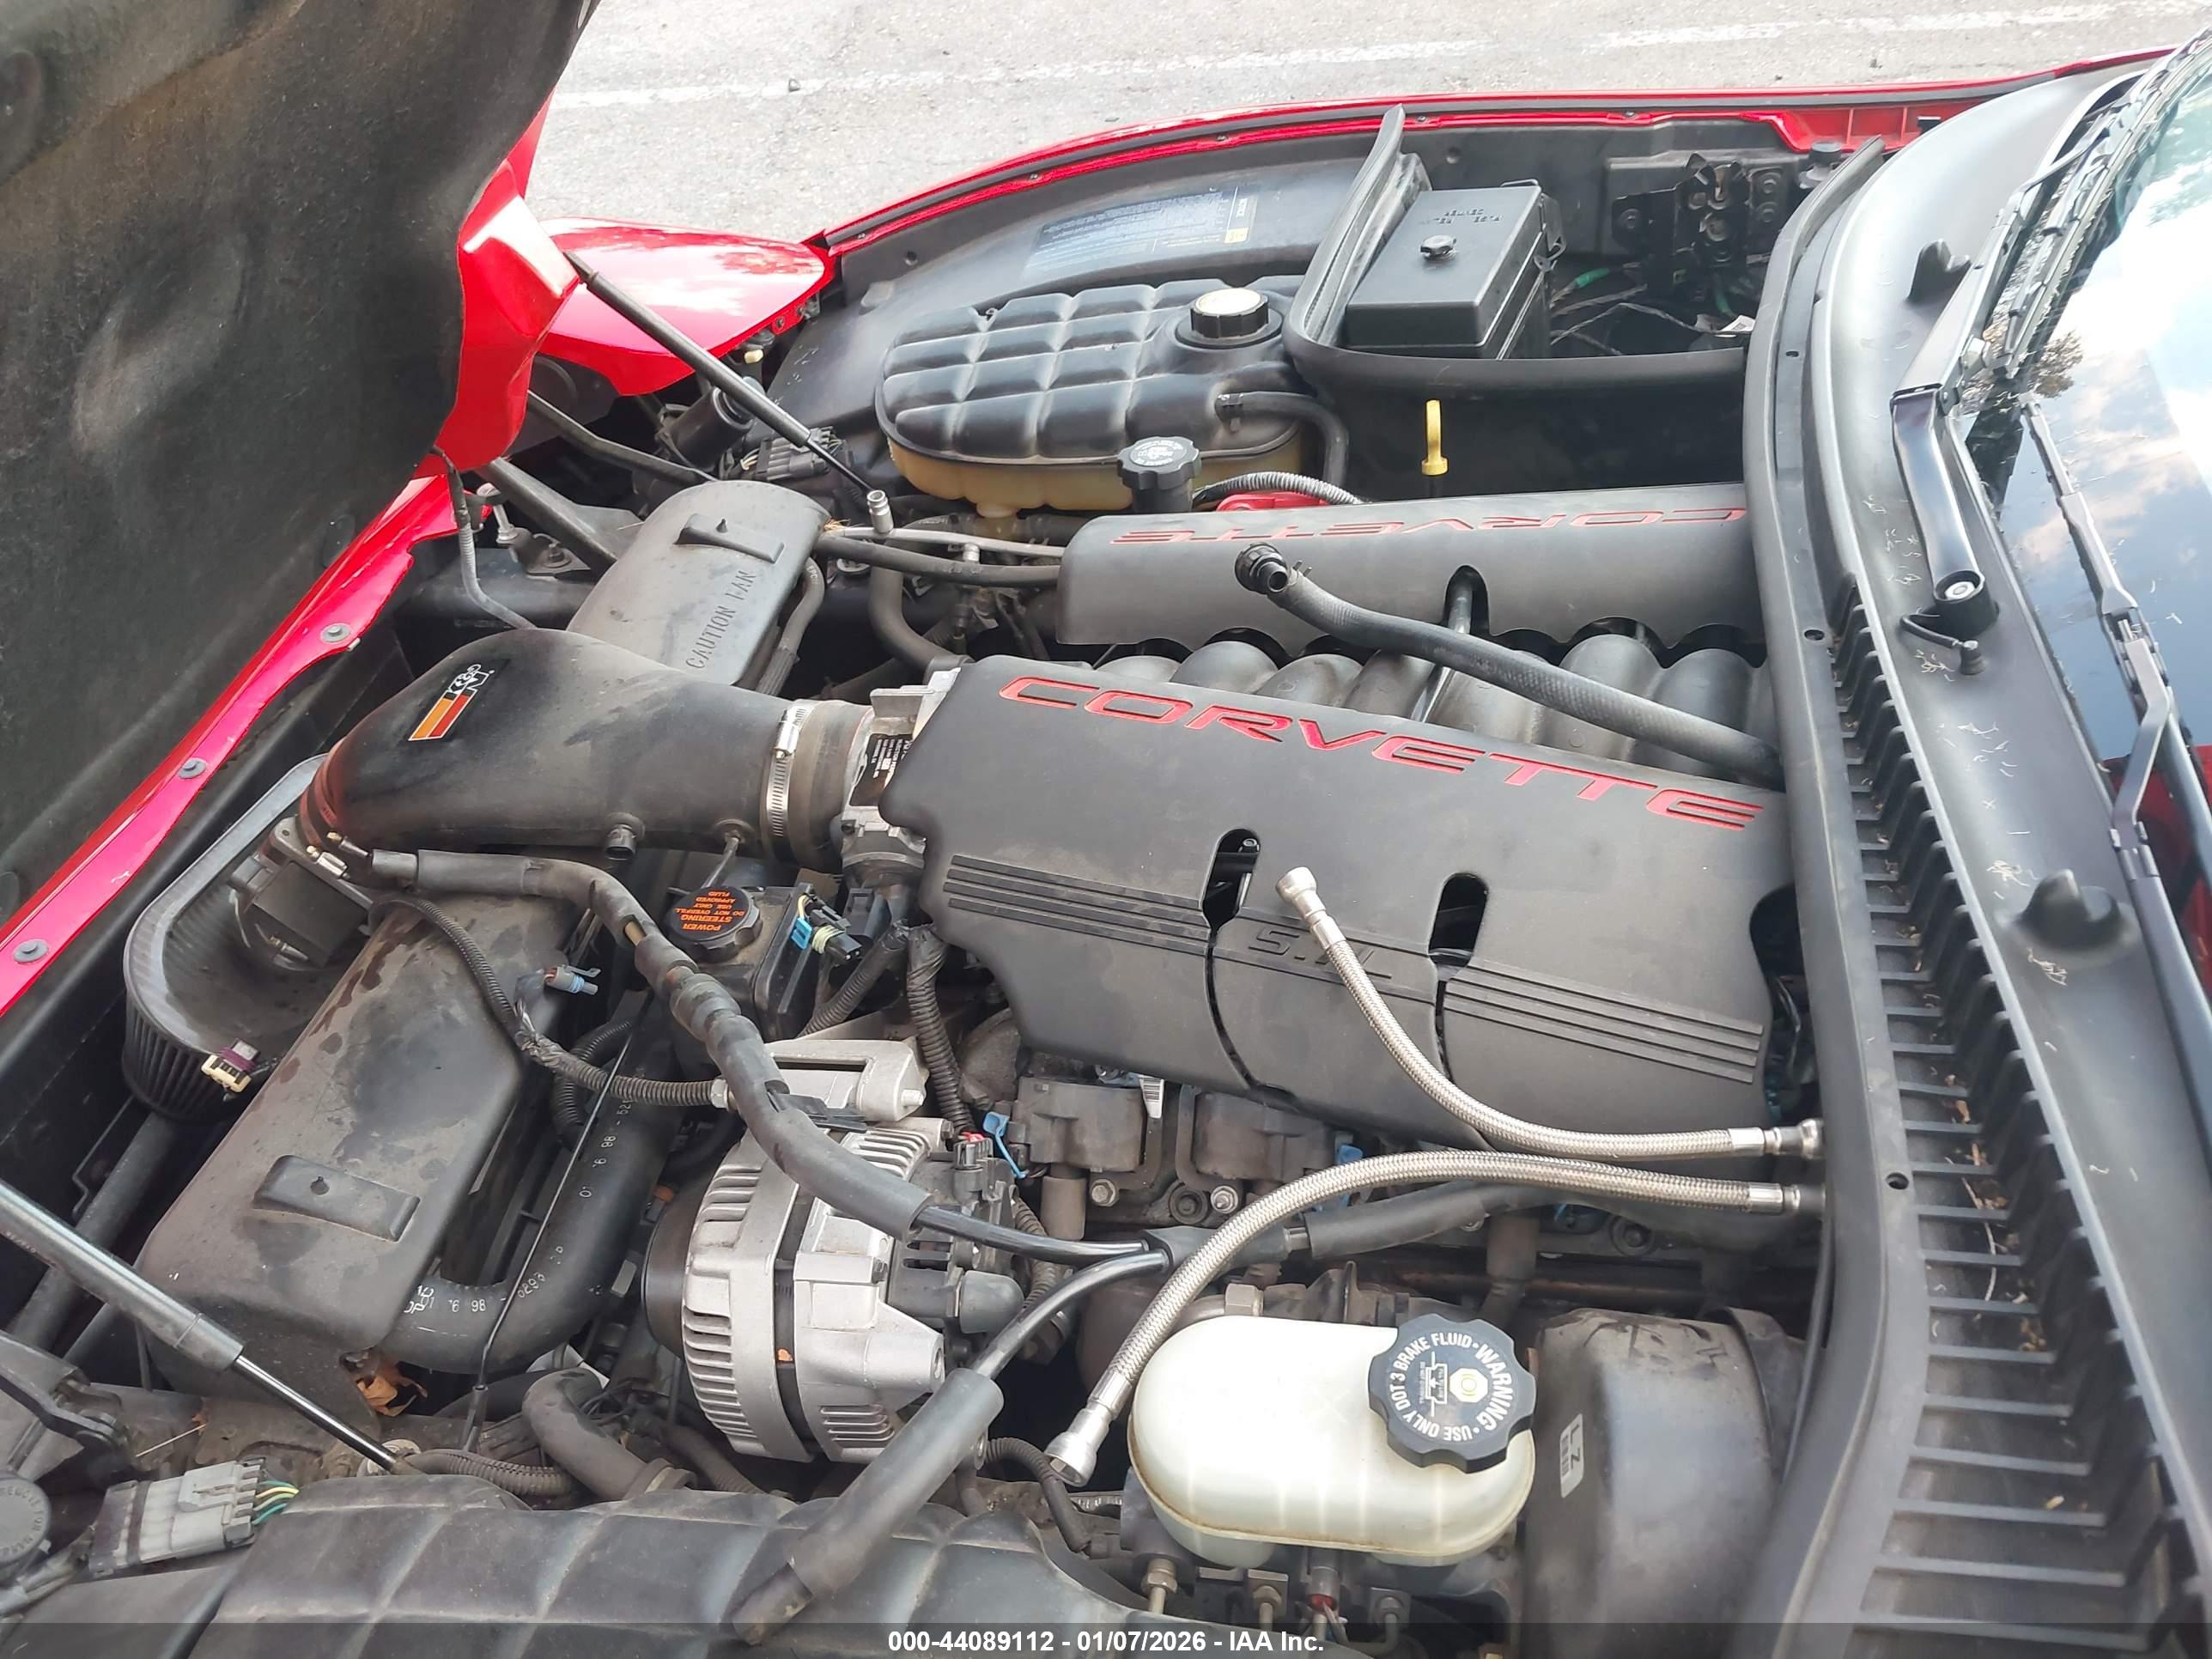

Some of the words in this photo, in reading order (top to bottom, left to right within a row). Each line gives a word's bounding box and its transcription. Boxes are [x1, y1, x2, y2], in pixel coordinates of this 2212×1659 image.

[1110, 508, 1746, 544] CORVETTE
[686, 605, 736, 669] CAUTION
[1000, 677, 1765, 831] CORVETTE
[680, 914, 732, 923] STEERING
[682, 923, 722, 932] POWER
[471, 1298, 487, 1312] 98
[1393, 1336, 1431, 1371] BRAKE
[1430, 1332, 1473, 1349] FLUID
[1390, 1372, 1407, 1382] 3
[1474, 1344, 1514, 1431] WARNING
[1389, 1384, 1412, 1412] DOT
[1402, 1409, 1440, 1438] ONLY
[1443, 1425, 1473, 1442] USE
